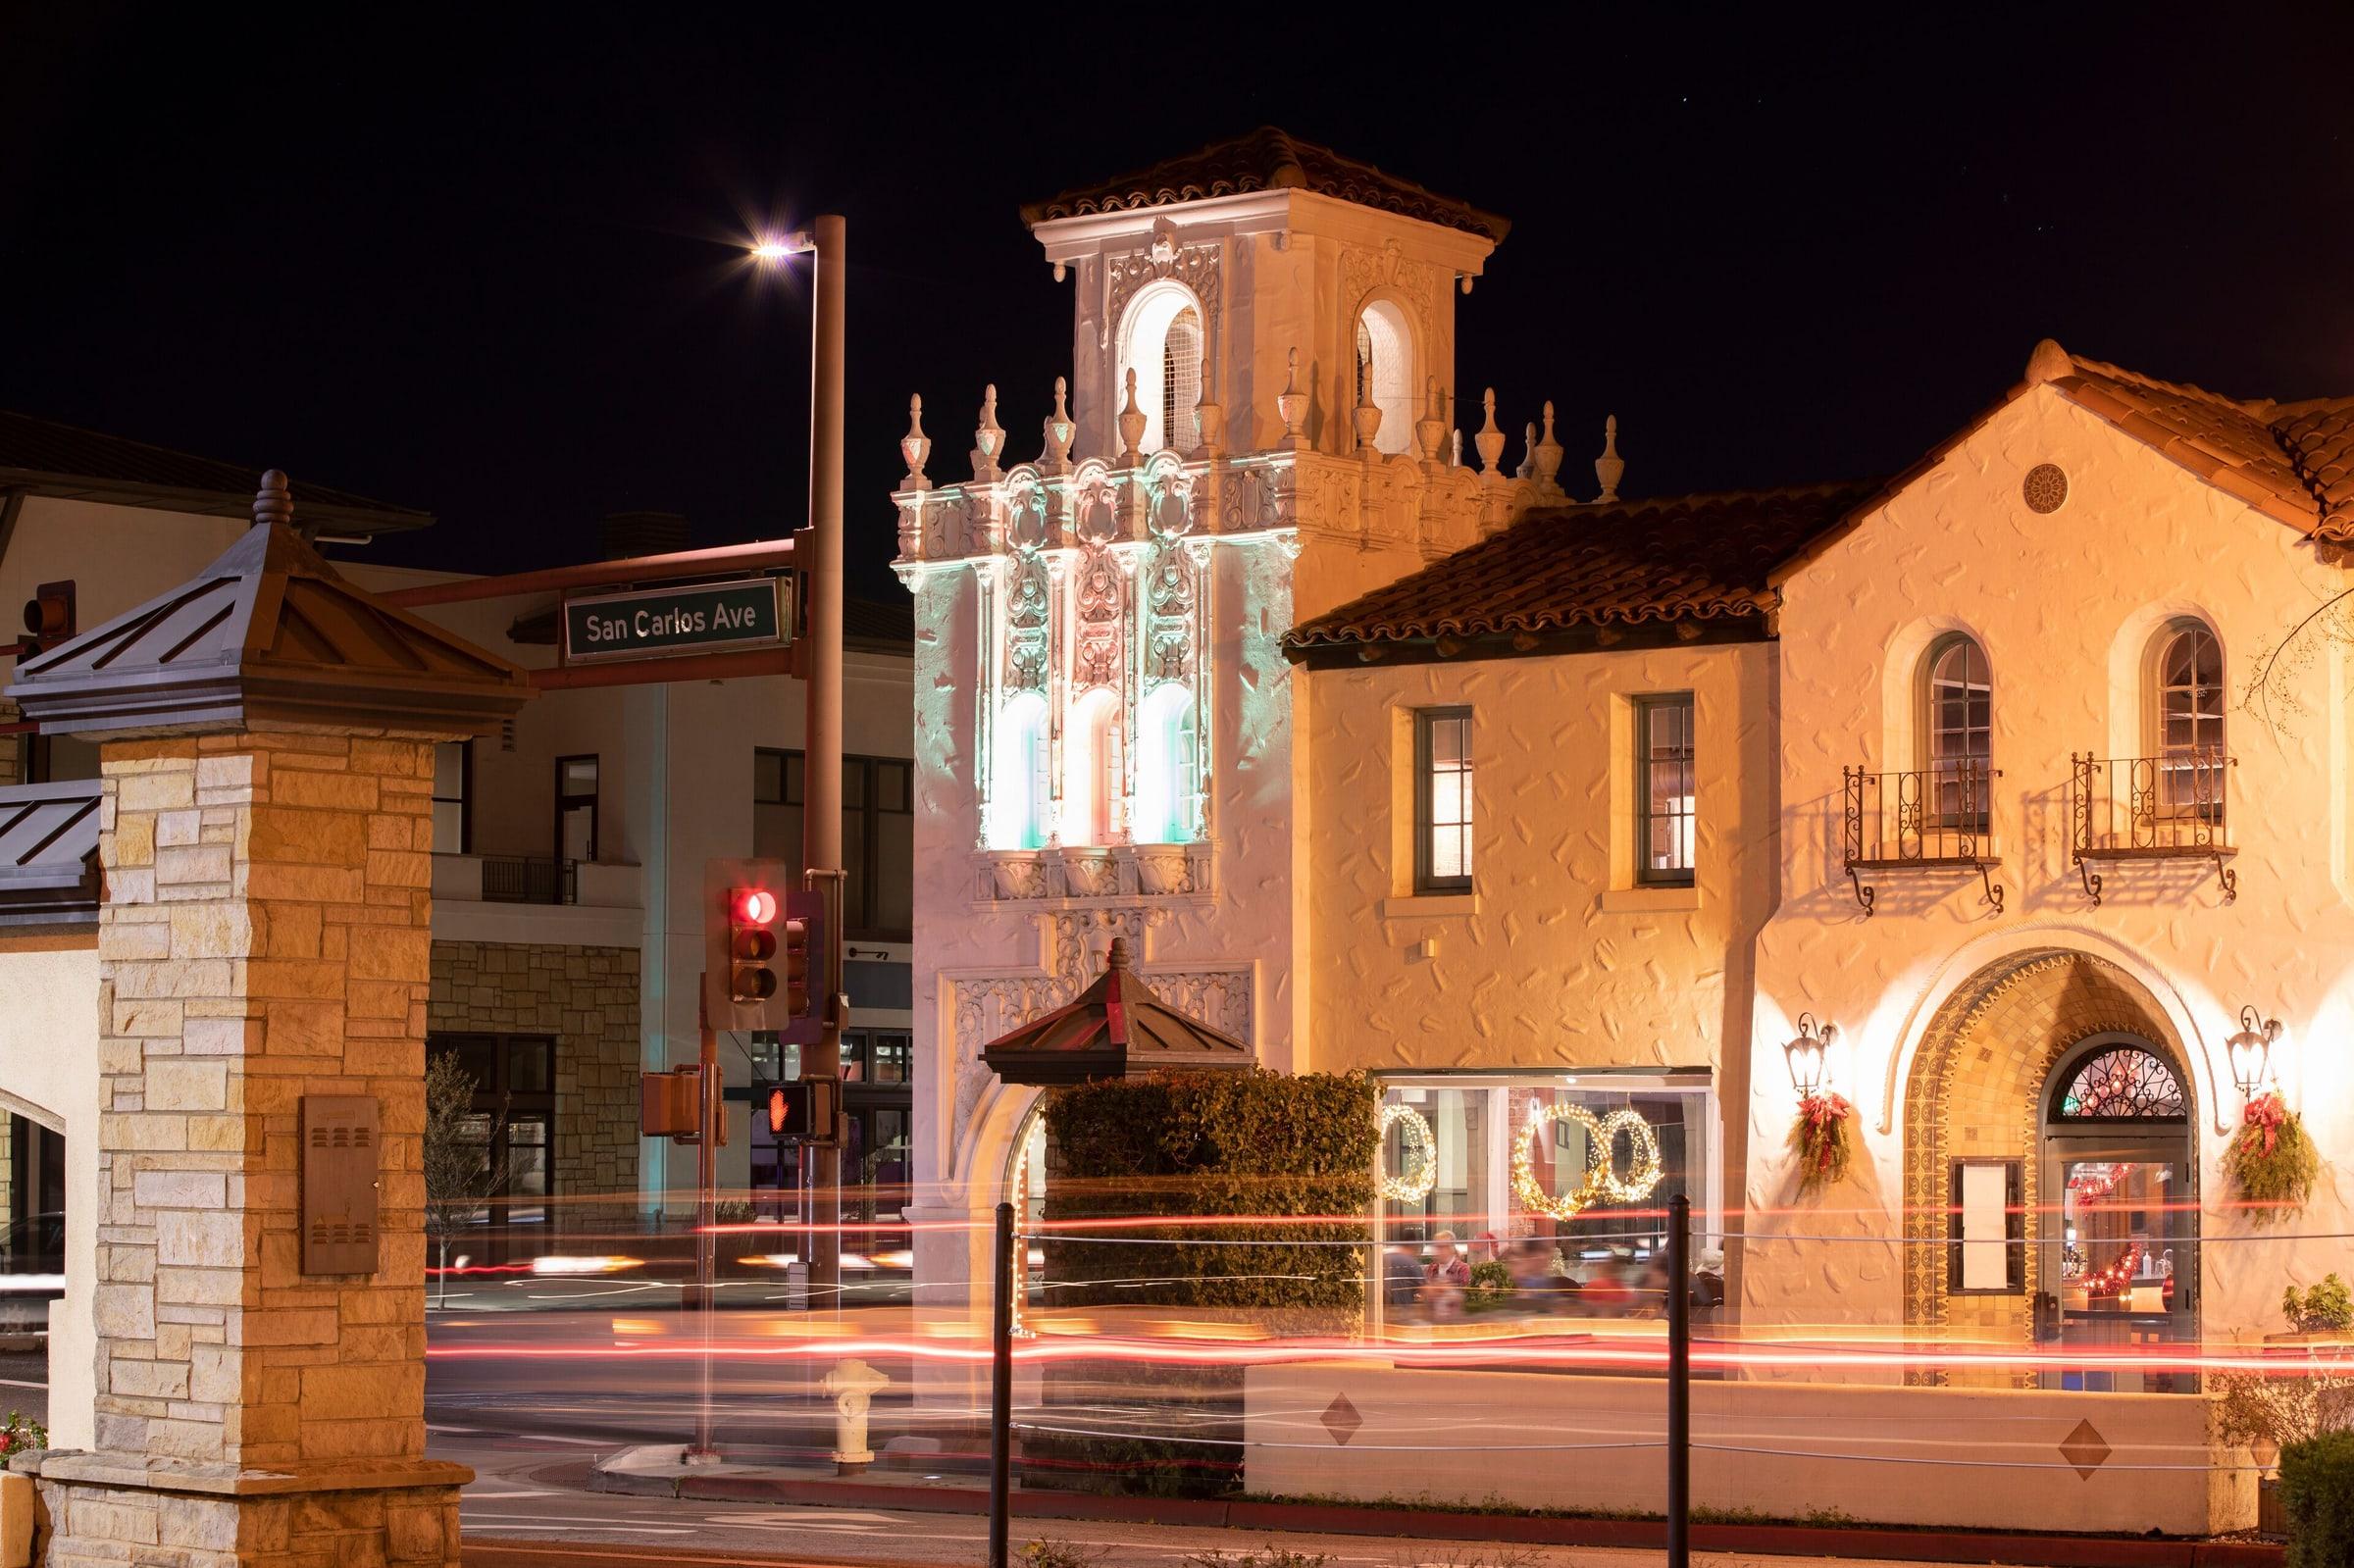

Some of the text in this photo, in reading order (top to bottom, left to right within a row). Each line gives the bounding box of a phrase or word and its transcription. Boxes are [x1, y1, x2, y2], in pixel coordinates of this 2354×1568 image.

[587, 602, 756, 642] San Carlos Ave
